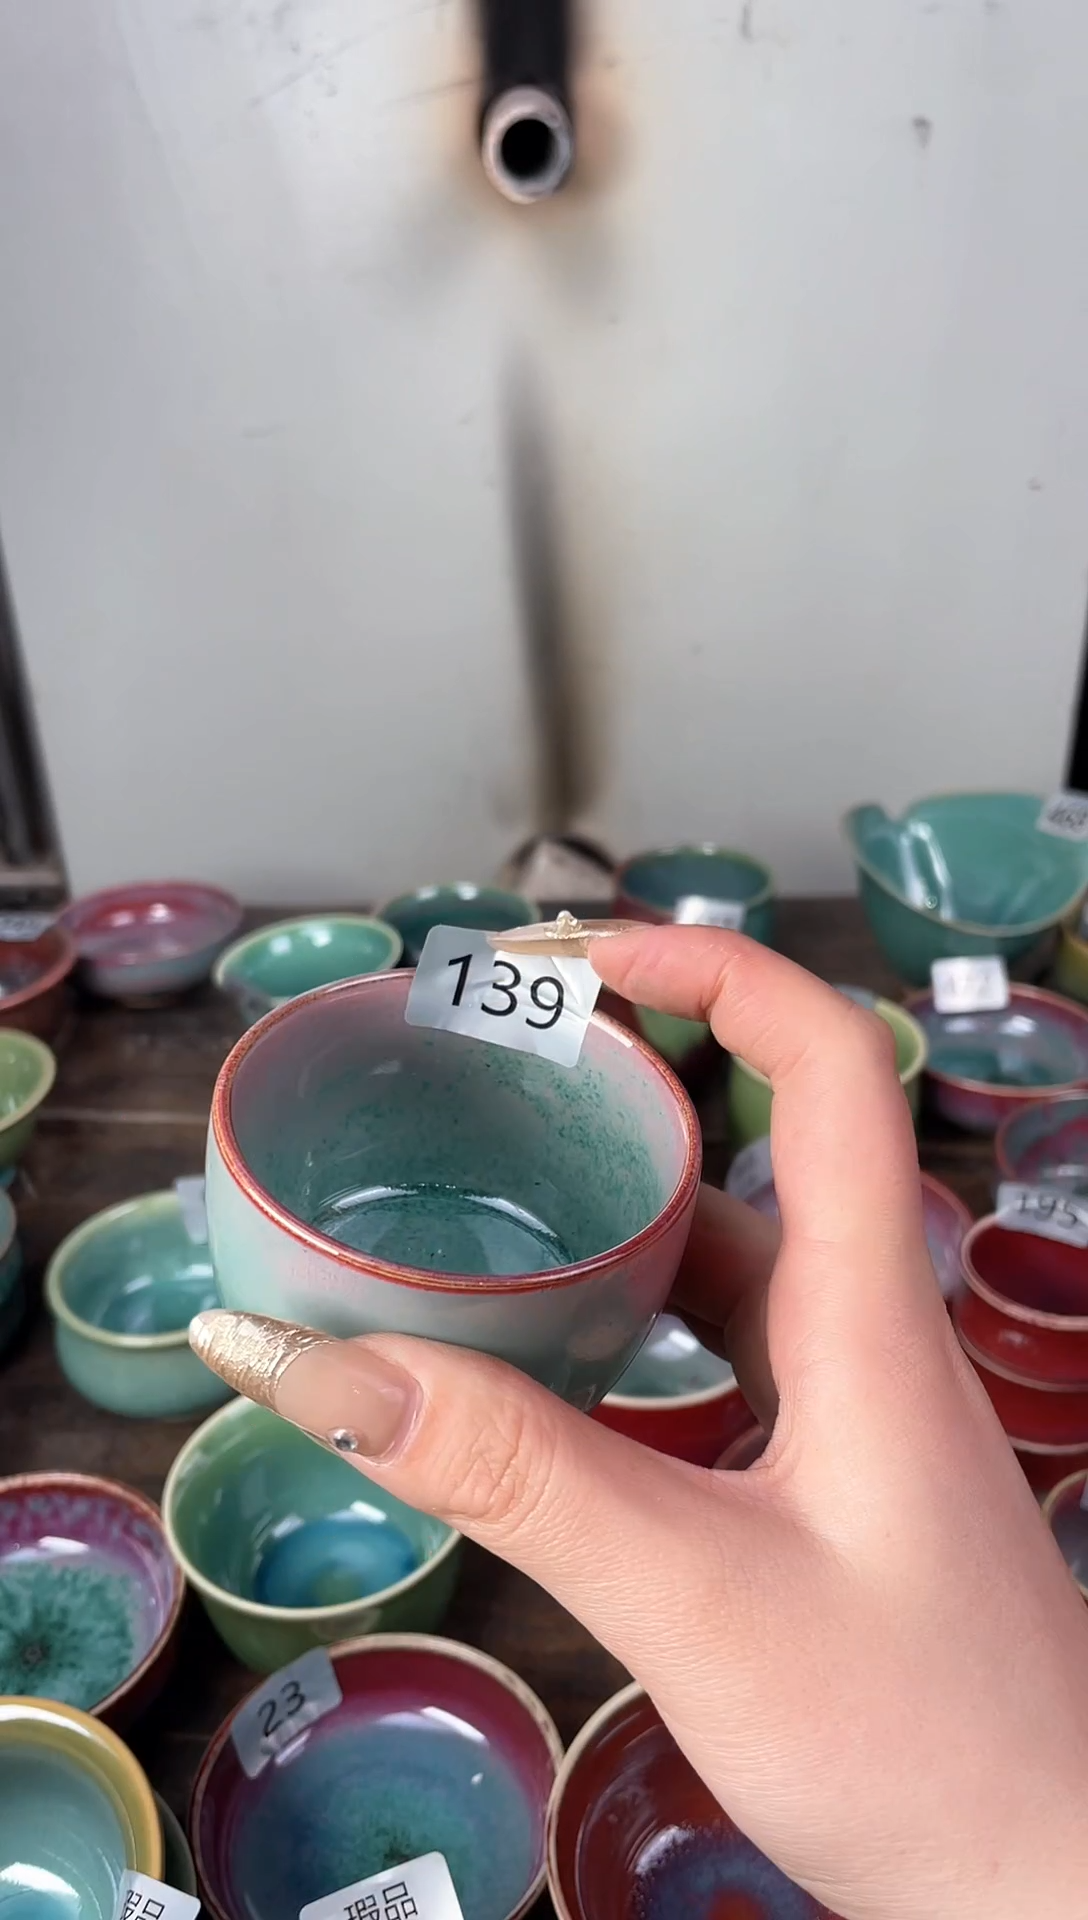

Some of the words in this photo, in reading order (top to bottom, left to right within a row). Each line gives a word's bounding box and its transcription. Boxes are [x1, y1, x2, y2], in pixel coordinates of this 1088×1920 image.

[447, 953, 565, 1030] 139
[1016, 1192, 1078, 1229] 195
[257, 1680, 306, 1738] 23
